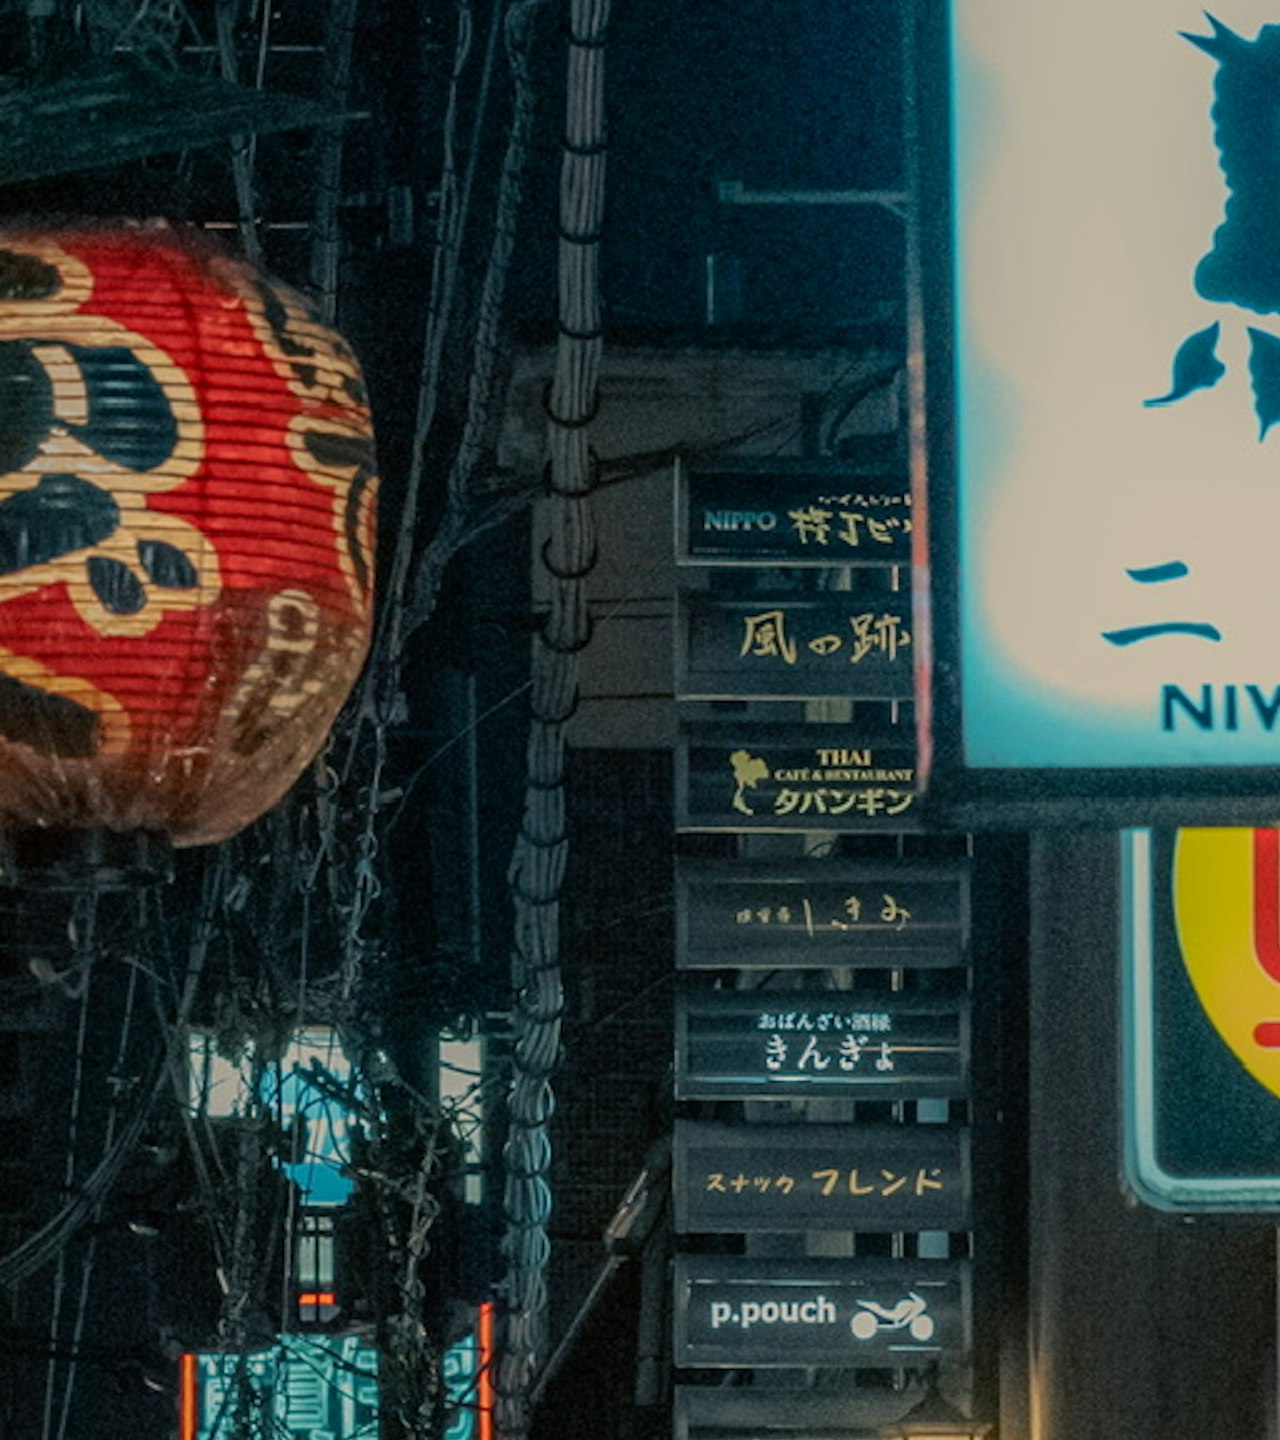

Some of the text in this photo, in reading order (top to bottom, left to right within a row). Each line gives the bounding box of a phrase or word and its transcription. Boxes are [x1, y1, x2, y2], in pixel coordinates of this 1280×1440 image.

[703, 510, 777, 532] NIPPO
[739, 610, 912, 666] 風の跡
[815, 748, 872, 767] THAI
[824, 769, 915, 782] RESTAURANT
[765, 1033, 894, 1072] きんぎょ
[706, 1168, 944, 1197] スナック フレンド
[710, 1295, 837, 1329] p.pouch
